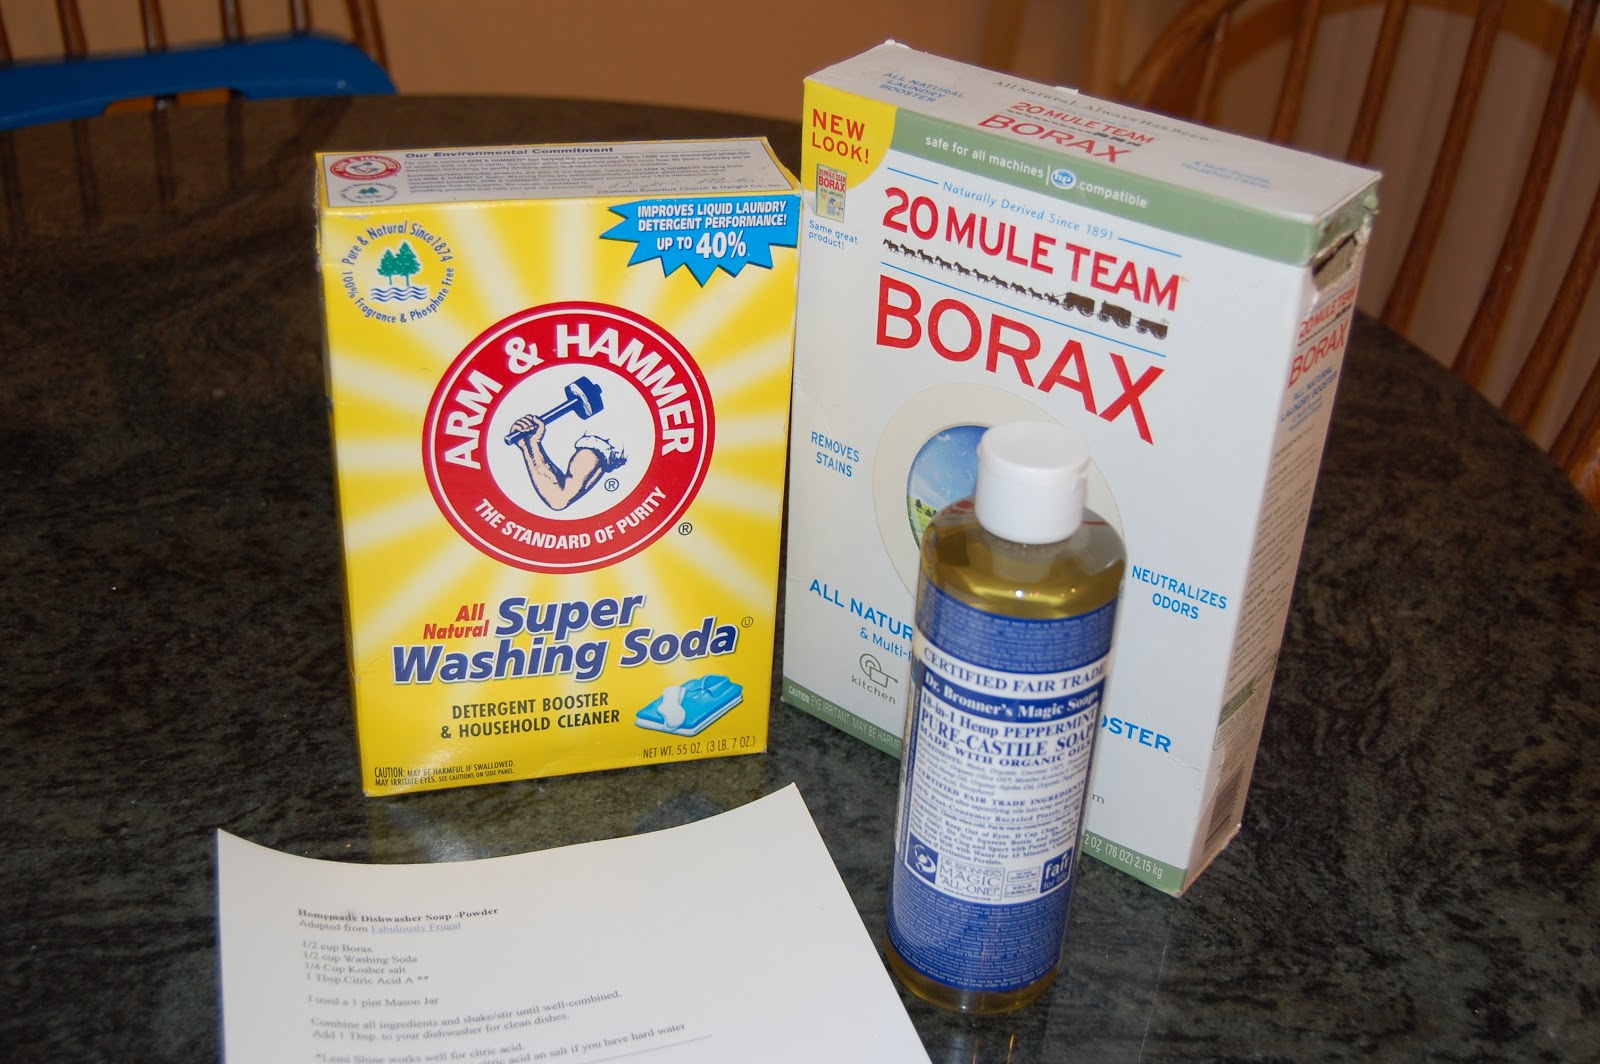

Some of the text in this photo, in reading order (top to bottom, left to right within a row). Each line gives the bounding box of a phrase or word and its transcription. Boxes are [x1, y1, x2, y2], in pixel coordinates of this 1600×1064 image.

[880, 84, 936, 102] BOOSTER
[883, 72, 966, 98] ALL NATURAL
[886, 80, 946, 98] LAUNDRY
[813, 109, 865, 141] NEW
[1011, 101, 1155, 144] 20 MULE TEAM
[434, 149, 527, 157] Environmental
[812, 132, 868, 164] LOOK!
[978, 114, 1133, 163] BORAX
[819, 175, 845, 193] BORAX
[925, 136, 1148, 208] safe for all machines compatible
[638, 200, 787, 218] IMPROVES LIQUID LAUNDRY
[638, 214, 788, 232] DETERGENT PERFORMANCE!
[943, 181, 1114, 241] Naturally Derived Since 1891
[341, 220, 454, 265] Pure Natural Since 1874
[656, 230, 747, 259] UP TO 40%
[809, 221, 858, 244] Same great
[809, 231, 844, 249] product!
[882, 186, 1181, 312] 20 MULE TEAM
[354, 267, 454, 323] Fragrance & Phosphate Free
[876, 274, 1165, 446] BORAX
[1288, 318, 1349, 388] BORAX
[444, 323, 695, 470] ARM & HAMMER
[811, 431, 860, 463] REMOVES
[816, 452, 852, 478] STAINS
[474, 485, 668, 550] THE STANDARD OF PURITY
[809, 579, 845, 608] ALL
[1131, 565, 1228, 610] NEUTRALIZES
[455, 593, 646, 643] All Super
[1152, 592, 1199, 620] ODORS
[422, 619, 489, 640] Natural
[860, 627, 869, 640] &
[391, 615, 740, 686] Washing Soda
[924, 647, 1008, 690] CERTIFIED
[1013, 681, 1056, 693] FAIR
[851, 675, 896, 704] kitchen
[925, 670, 1099, 720] Dr. Bronner's Magic Soaps
[452, 691, 609, 720] DETERGENT BOOSTER
[922, 692, 1096, 739] 18-in-1 Hemp PEPPERMINT
[440, 709, 620, 739] & HOUSEHOLD CLEANER
[921, 708, 1094, 757] PURE-CASTILE SOAP
[643, 735, 756, 759] NET WT. 55 OZ. (3 LB. OZ.)
[919, 724, 950, 750] MADE
[955, 749, 993, 764] WITH
[999, 754, 1063, 767] ORGANIC
[374, 767, 405, 778] CAUTION:
[433, 766, 463, 775] HARMFUL
[474, 760, 516, 771] SWALLOWED.
[375, 778, 388, 786] MAY
[391, 777, 418, 786] IRRITATE
[449, 772, 474, 781] CAUTIONS
[940, 864, 1000, 887] MAGIC
[1044, 852, 1070, 880] fair
[1106, 843, 1163, 879] (76 OZ) 2.15 kg
[298, 907, 500, 923] Homemade Dishwasher Soap -Powder
[299, 919, 462, 934] Adapted from Fabulously Frugal
[304, 951, 319, 959] 1/2
[322, 954, 341, 963] cup
[344, 954, 389, 965] Washing
[320, 943, 373, 953] cup Borax
[305, 962, 406, 974] 1/4 Cup Kosher salt
[314, 973, 401, 985] Tbsp Citric Acid
[311, 990, 622, 1031] Combine ingredients and shake/stir until well-combined.
[315, 997, 439, 1008] used pint Mason Jar
[313, 1013, 570, 1042] Add your dishwasher clean dishes.
[631, 1023, 686, 1042] hard water
